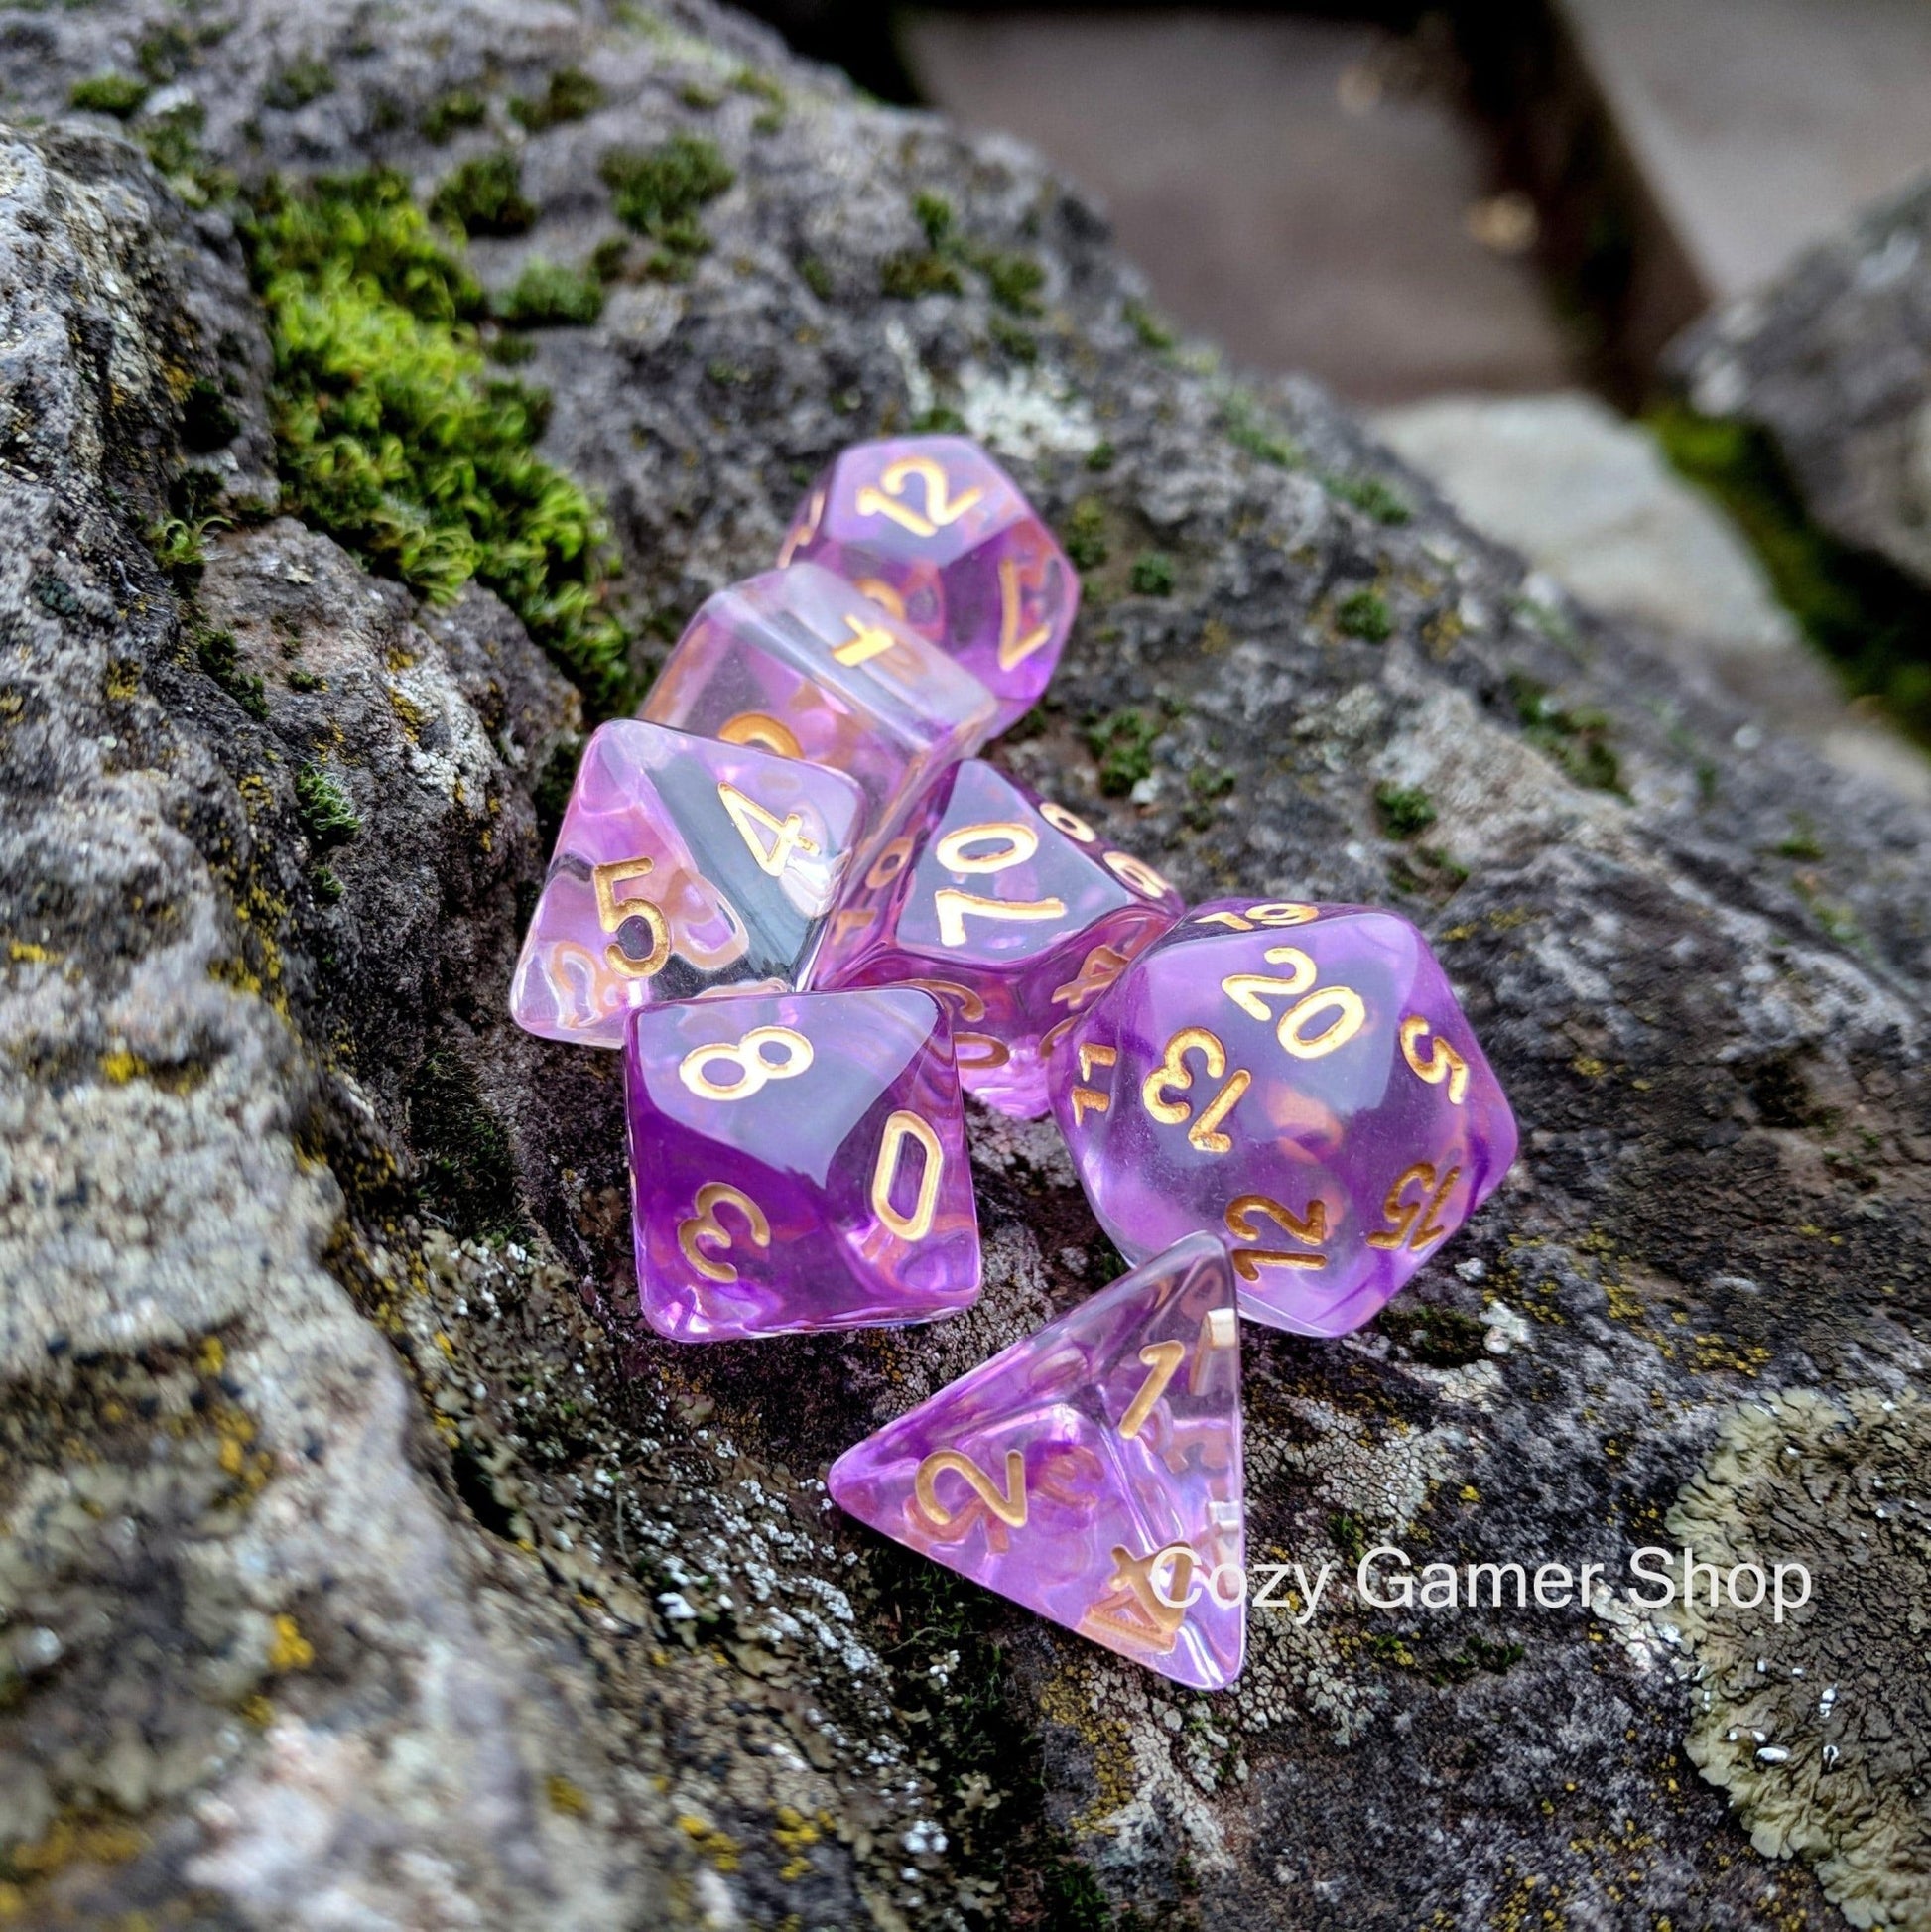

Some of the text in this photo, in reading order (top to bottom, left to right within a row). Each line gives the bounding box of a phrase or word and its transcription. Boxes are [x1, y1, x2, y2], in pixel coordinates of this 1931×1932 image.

[856, 456, 981, 537] 12
[718, 781, 821, 877] 4
[593, 856, 672, 978] 5
[935, 822, 1068, 947] 70
[1196, 902, 1321, 931] 19
[1221, 946, 1366, 1060] 20
[679, 1025, 814, 1100] 8
[1142, 1026, 1252, 1154] 13
[1398, 1015, 1470, 1105] 5
[871, 1109, 944, 1241] 0
[677, 1181, 771, 1283] 3
[1223, 1194, 1330, 1283] 12
[1118, 1339, 1186, 1440] 1
[914, 1449, 1029, 1529] 2
